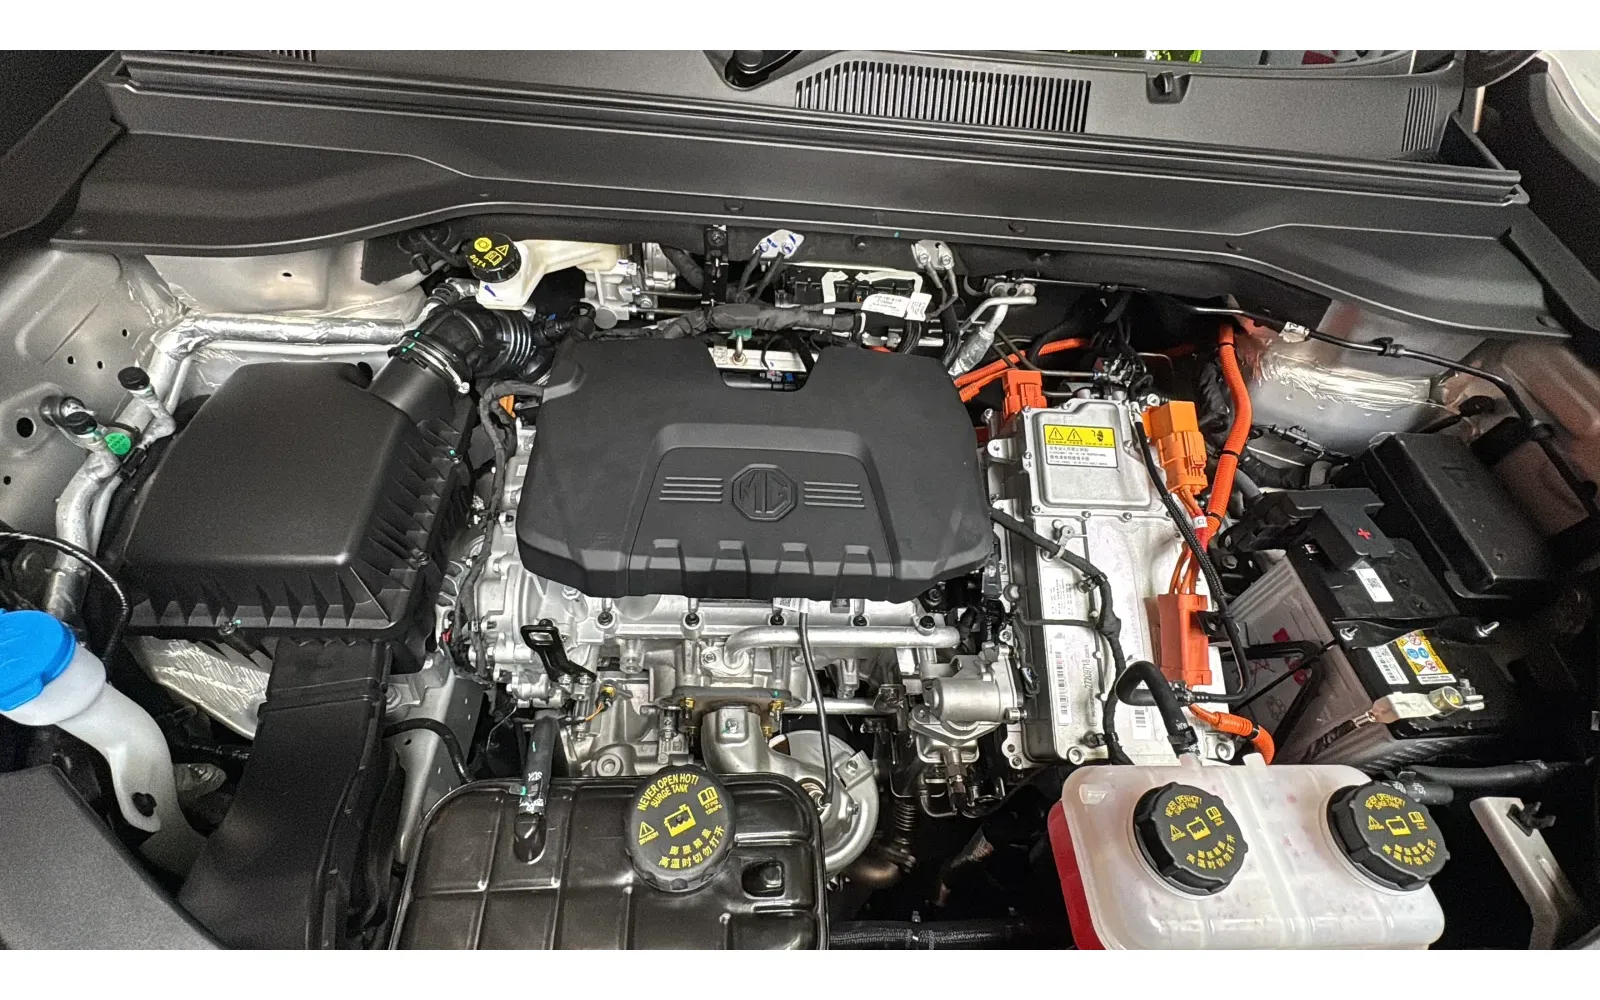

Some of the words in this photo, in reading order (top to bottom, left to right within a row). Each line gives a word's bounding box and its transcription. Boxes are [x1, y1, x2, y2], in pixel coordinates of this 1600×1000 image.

[469, 254, 487, 268] DOT4
[736, 467, 793, 518] MG
[637, 784, 660, 811] NEVER
[657, 773, 679, 789] OPEN
[679, 773, 699, 786] HOT!
[650, 787, 672, 808] SURGE
[671, 783, 689, 794] TANK
[658, 825, 725, 869] 高温时切勿打开
